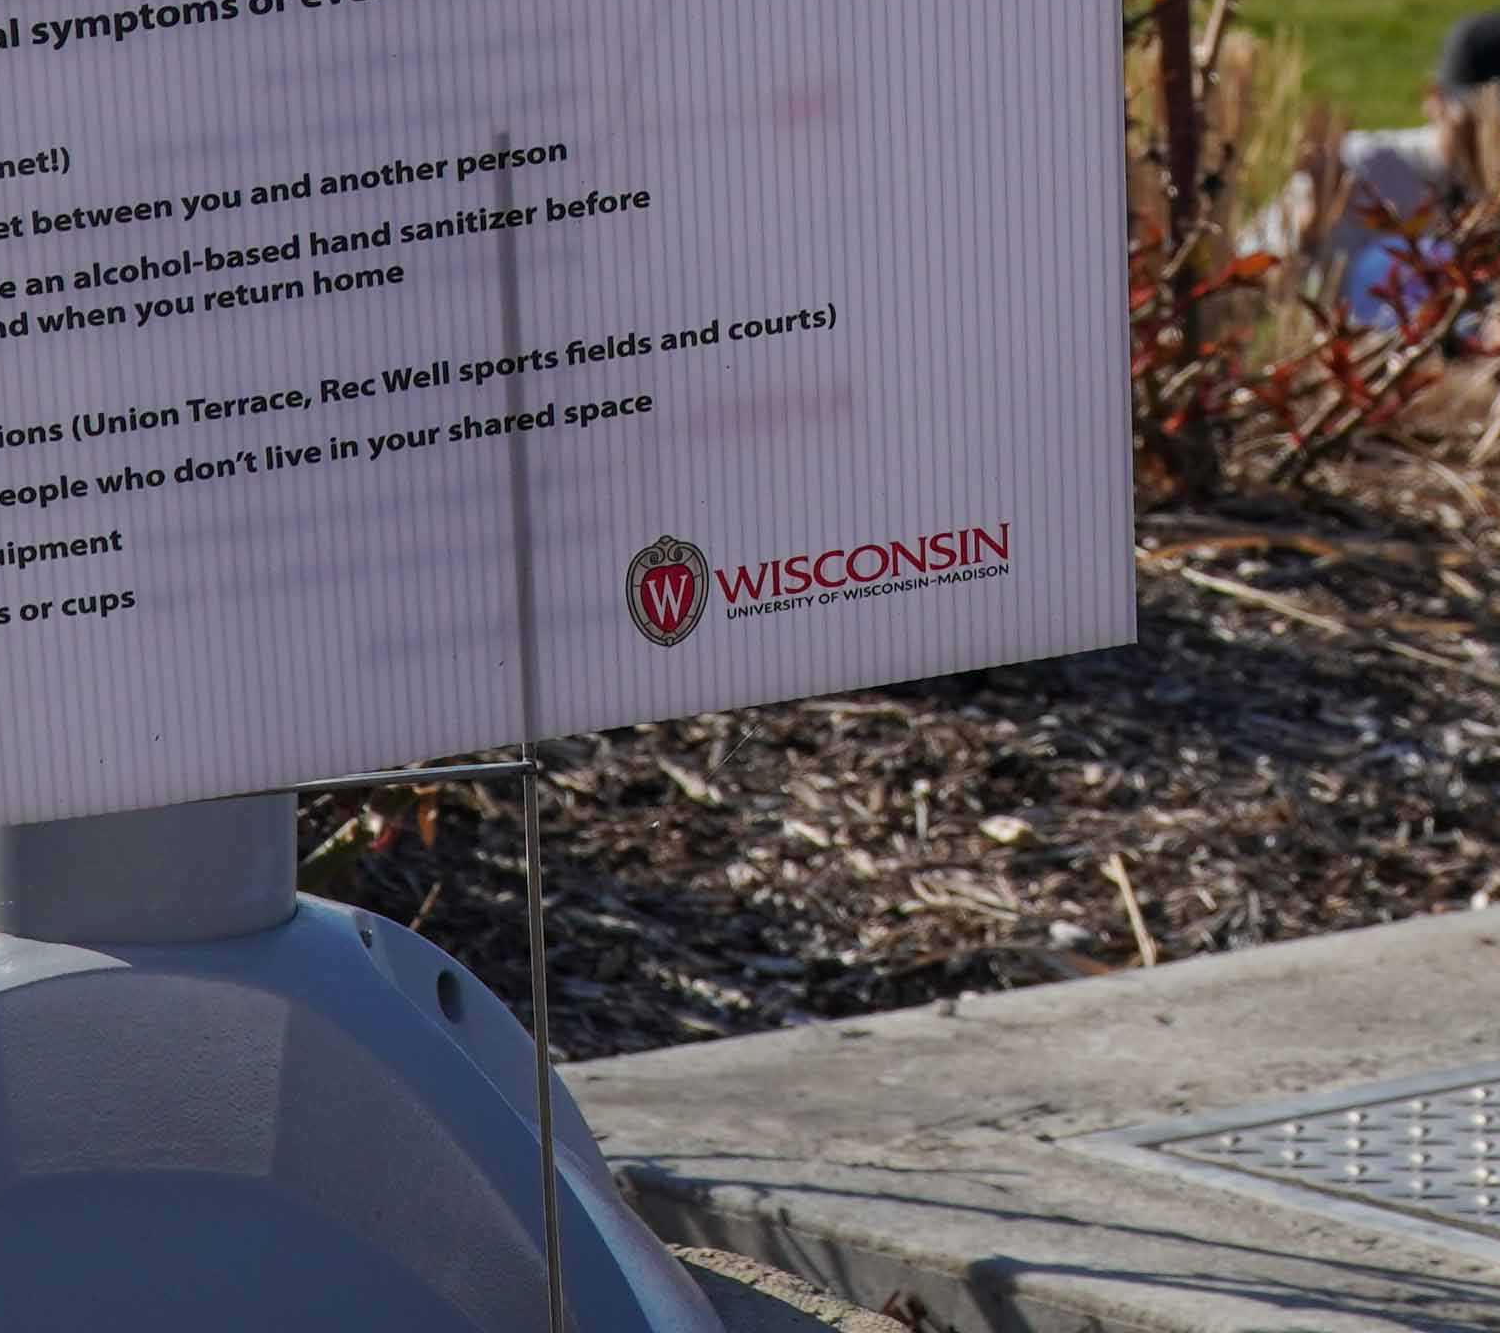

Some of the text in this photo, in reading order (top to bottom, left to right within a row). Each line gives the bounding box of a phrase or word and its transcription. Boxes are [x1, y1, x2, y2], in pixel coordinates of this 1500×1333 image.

[31, 199, 174, 236] between
[180, 189, 242, 222] you
[250, 172, 312, 206] and
[319, 159, 449, 196] another
[456, 140, 568, 183] person
[25, 274, 65, 297] an
[73, 233, 301, 291] alcohol-based
[309, 220, 392, 258] hand
[399, 206, 539, 244] sanitizer
[545, 189, 651, 223] before
[36, 304, 127, 334] when
[133, 295, 195, 328] you
[203, 279, 305, 312] return
[312, 265, 405, 296] home
[71, 406, 180, 443] (Union
[185, 389, 313, 423] Terrace,
[319, 377, 377, 404] Rec
[380, 360, 451, 394] Well
[458, 340, 560, 387] sports
[564, 331, 653, 367] fields
[660, 318, 720, 352] and
[728, 301, 837, 341] courts)
[95, 465, 166, 494] who
[265, 444, 323, 471] live
[329, 436, 360, 461] in
[366, 426, 441, 461] your
[447, 400, 556, 443] shared
[563, 394, 653, 429] space
[645, 573, 688, 626] W
[714, 522, 1011, 604] WISCONSIN
[19, 600, 54, 622] or
[61, 590, 136, 618] cups
[726, 594, 815, 620] UNIVERSITY
[818, 591, 840, 605] OF
